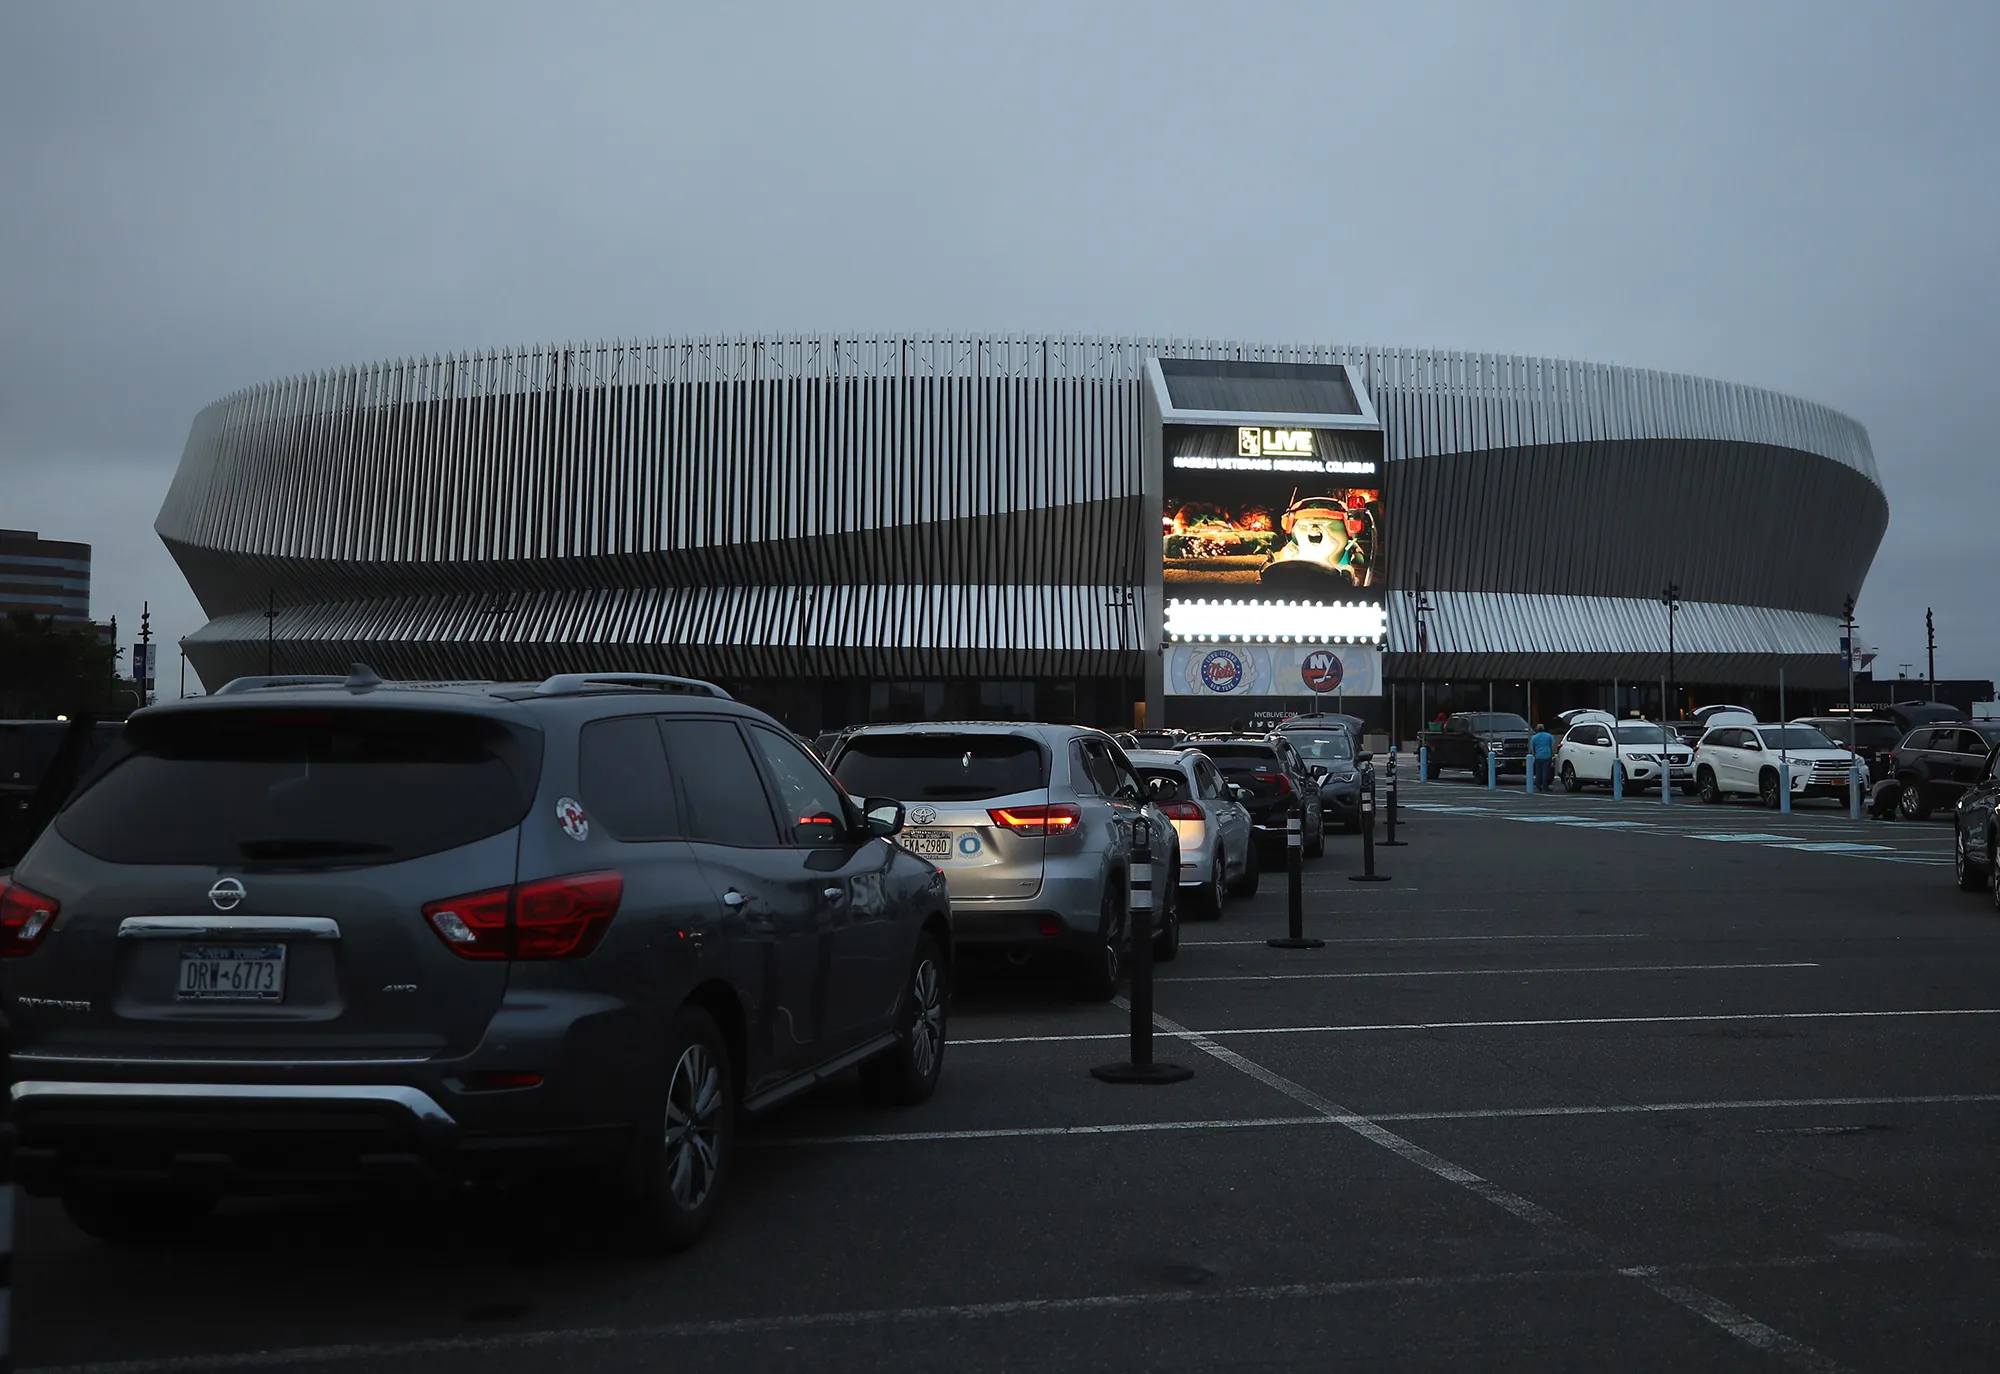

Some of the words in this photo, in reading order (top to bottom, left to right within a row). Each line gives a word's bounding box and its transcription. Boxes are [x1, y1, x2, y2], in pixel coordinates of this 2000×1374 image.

[1263, 430, 1312, 451] LIVE
[1310, 654, 1335, 677] NY
[926, 840, 947, 853] 2980
[187, 962, 220, 990] DRW
[232, 962, 275, 990] 6773
